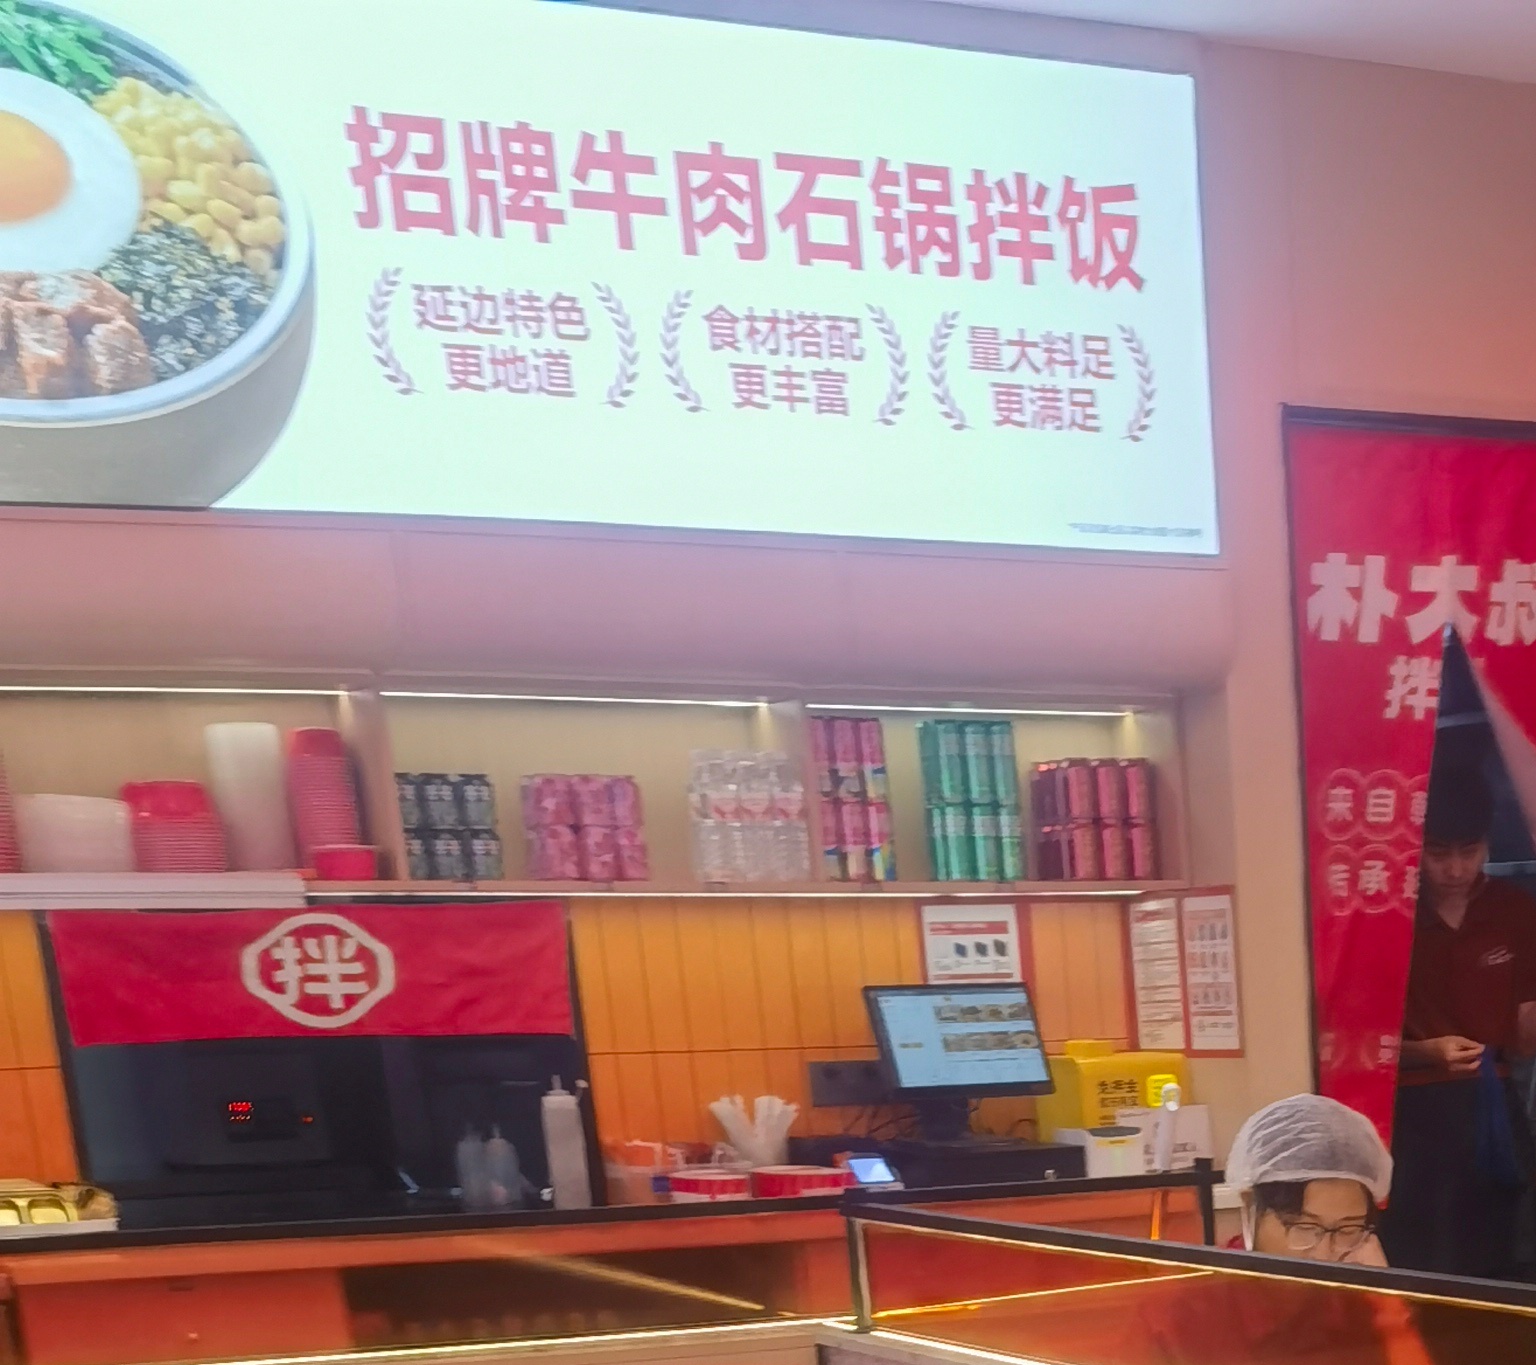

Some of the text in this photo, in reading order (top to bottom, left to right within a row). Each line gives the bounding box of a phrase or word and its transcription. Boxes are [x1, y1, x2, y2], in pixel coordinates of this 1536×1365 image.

[345, 106, 1146, 294] 招牌牛肉石锅拌饭
[413, 284, 591, 342] 延边特色
[703, 304, 867, 363] 食材搭配
[444, 343, 577, 399] 更地道
[967, 326, 1117, 382] 量大料足
[730, 363, 851, 418] 更丰富
[990, 382, 1104, 434] 更满足
[271, 933, 369, 1010] 拌
